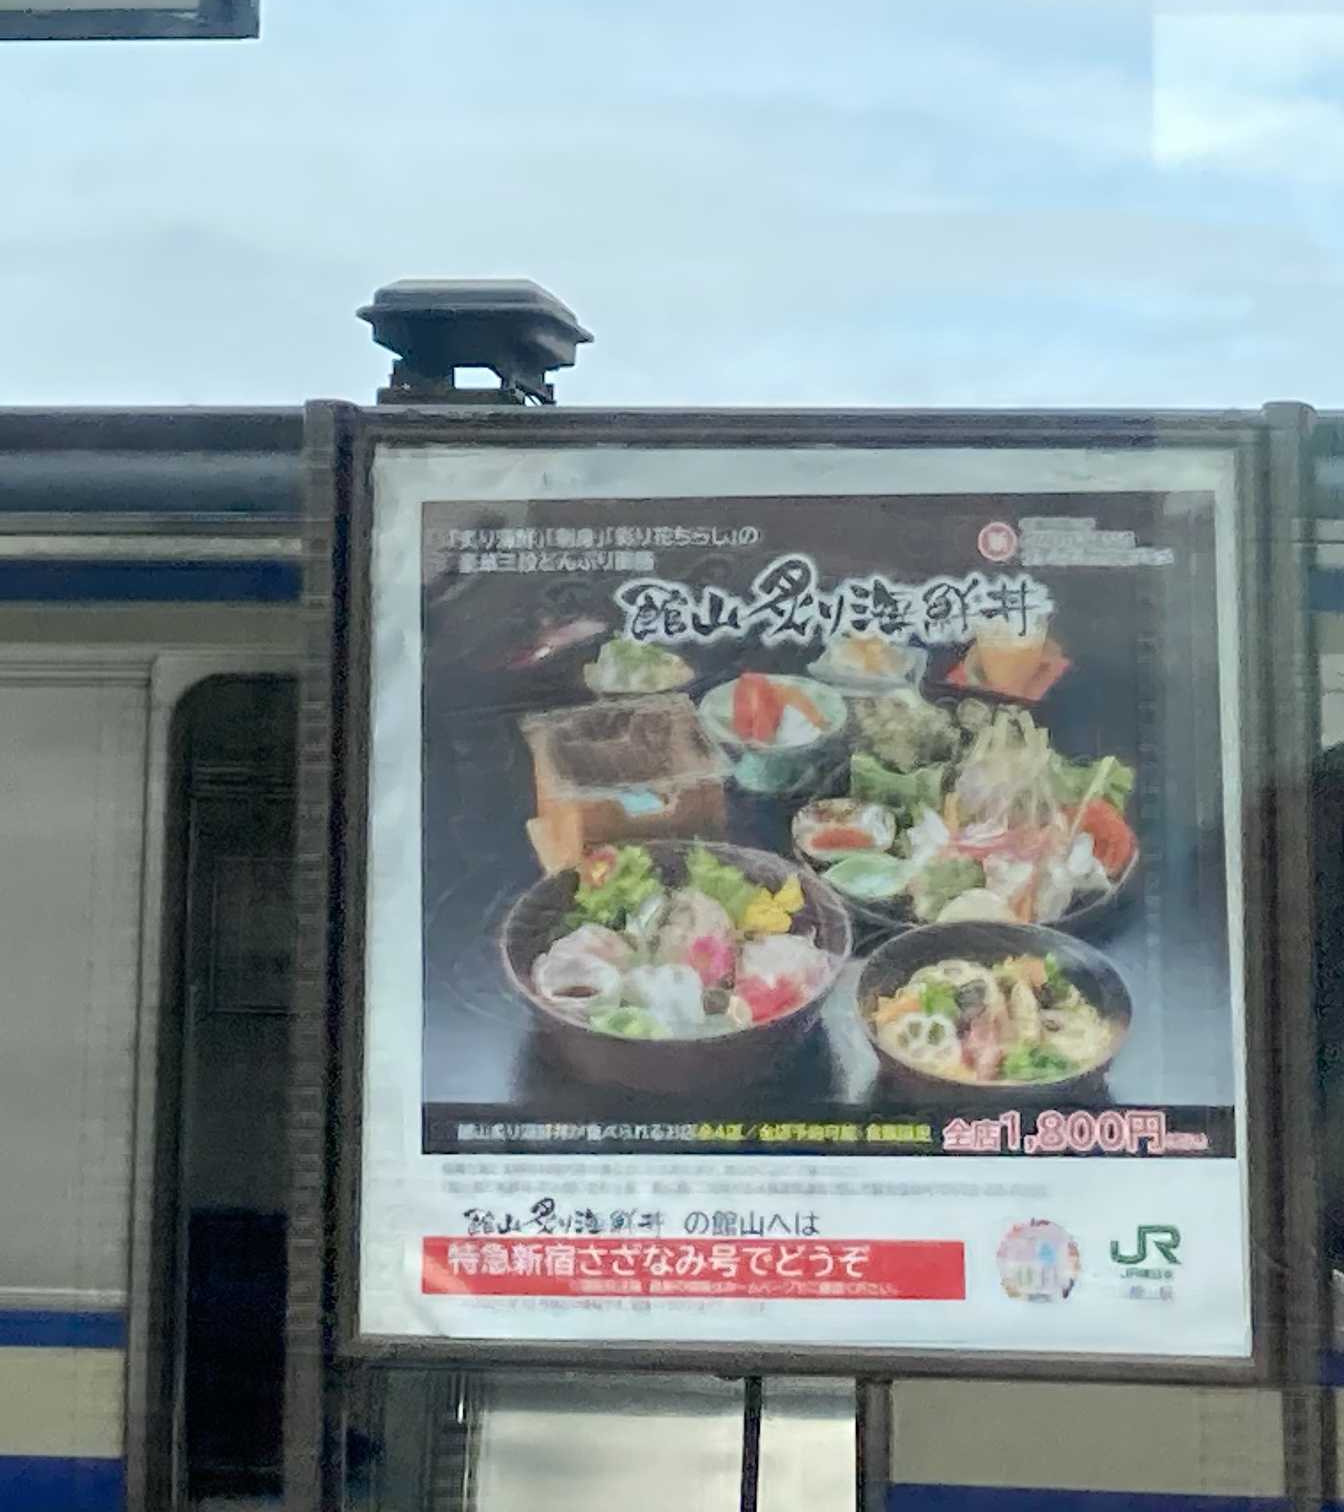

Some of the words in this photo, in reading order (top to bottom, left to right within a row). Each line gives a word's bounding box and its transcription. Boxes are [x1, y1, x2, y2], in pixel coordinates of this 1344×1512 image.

[684, 1210, 820, 1236] の館山へは
[448, 1243, 870, 1278] 特急新宿さざなみ号でどうぞ
[1110, 1224, 1182, 1265] JR
